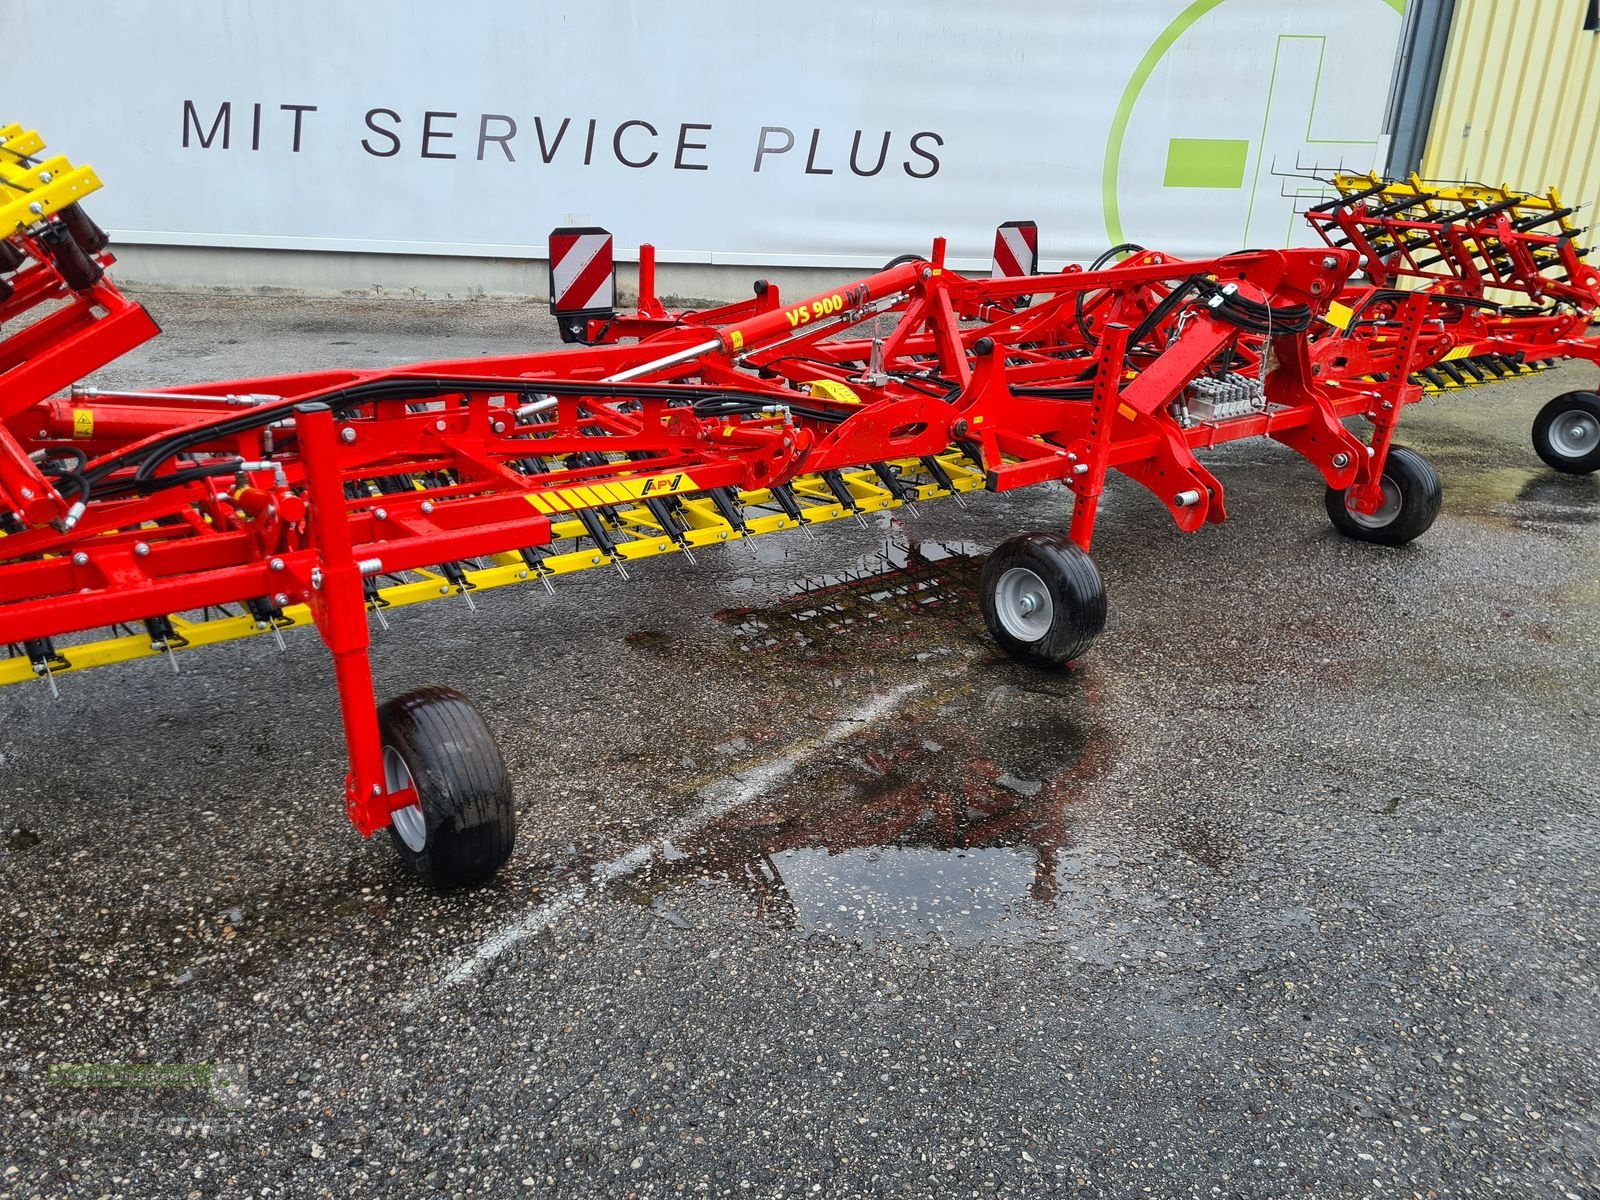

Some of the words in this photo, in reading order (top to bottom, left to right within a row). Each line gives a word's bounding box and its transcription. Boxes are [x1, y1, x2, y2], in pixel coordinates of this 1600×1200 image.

[182, 99, 318, 153] MIT
[360, 107, 713, 171] SERVICE
[752, 125, 945, 179] PLUS
[785, 305, 810, 326] VS
[812, 294, 843, 318] 900
[644, 476, 680, 493] APV
